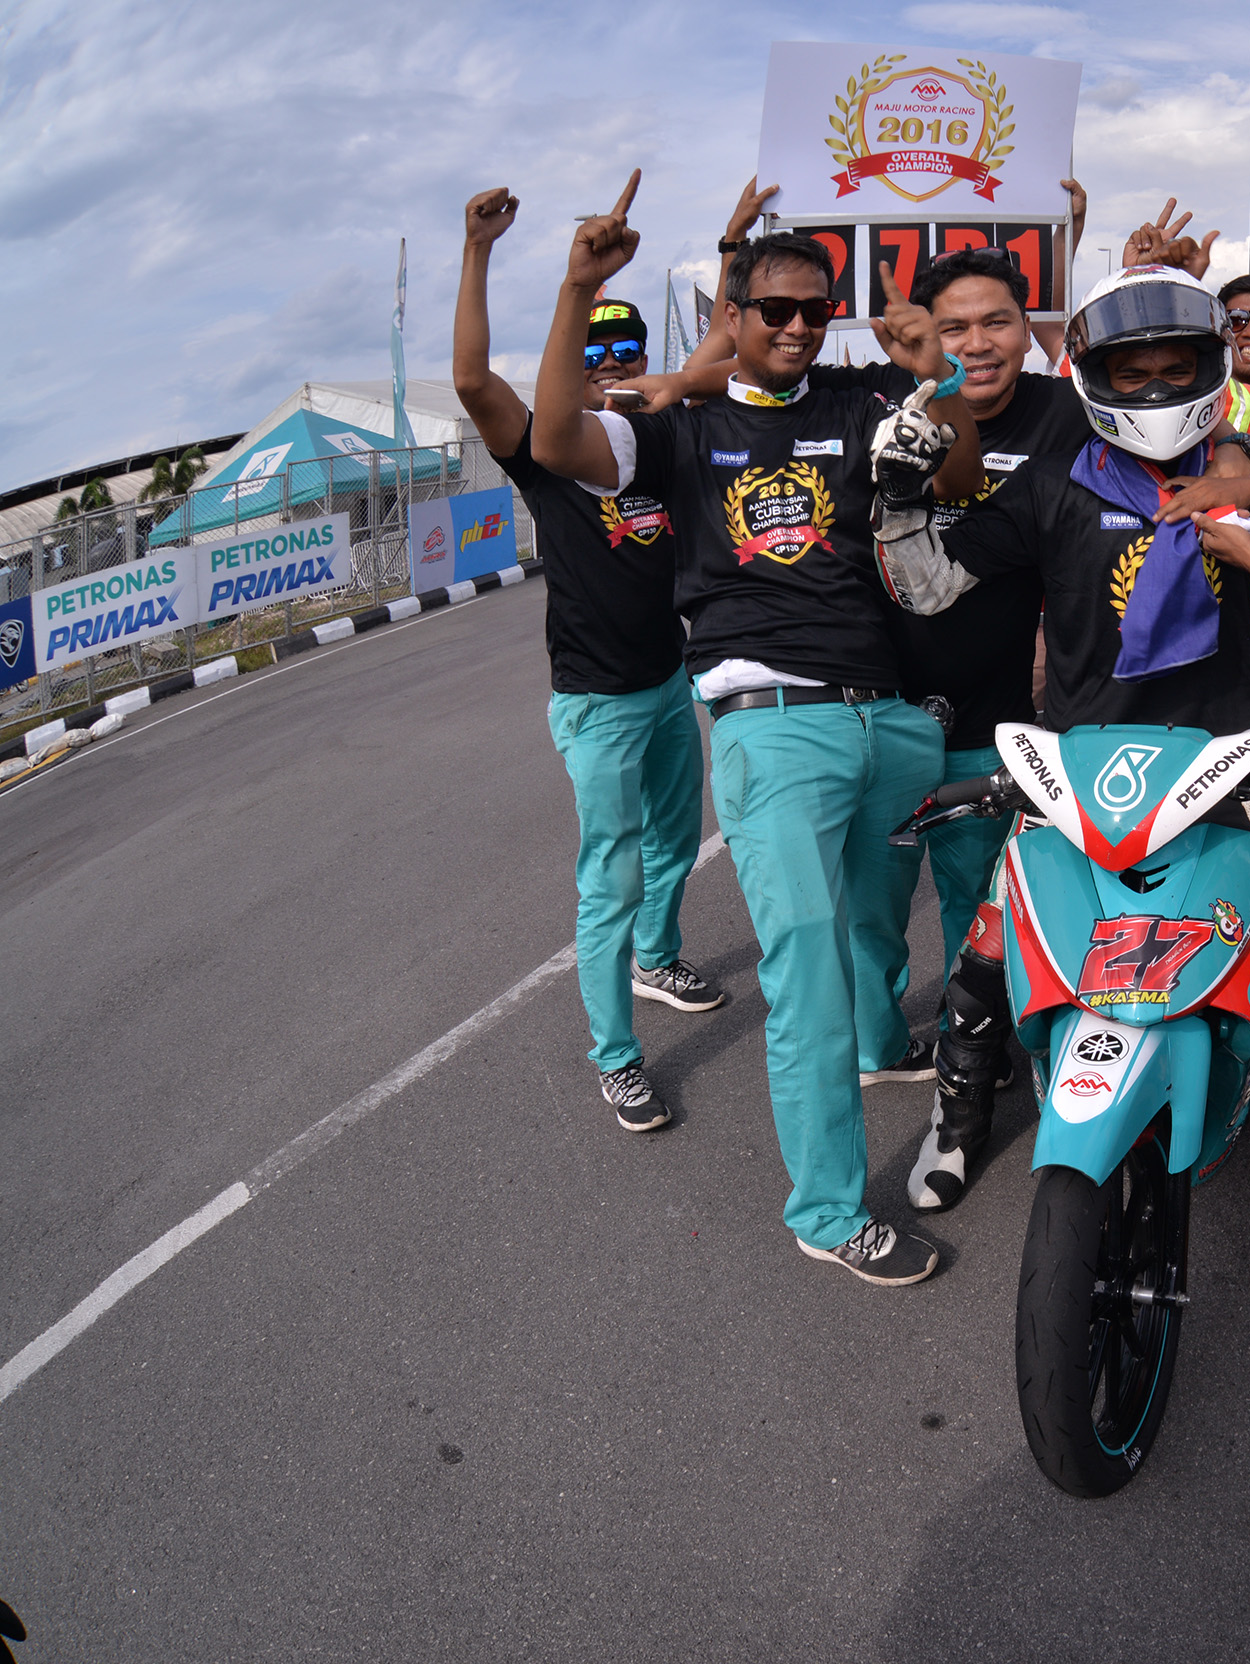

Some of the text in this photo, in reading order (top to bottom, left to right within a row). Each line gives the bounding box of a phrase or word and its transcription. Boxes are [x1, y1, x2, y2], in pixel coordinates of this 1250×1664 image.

[874, 103, 976, 116] MAJU MOTOR RACING
[877, 116, 969, 146] 2016
[891, 152, 950, 164] OVERALL
[886, 161, 954, 174] CHAMPION
[721, 453, 749, 462] YAMAHA
[758, 482, 796, 500] 206
[748, 501, 767, 512] AAM
[1111, 515, 1141, 525] YAMAHA
[767, 528, 801, 539] OVERALL
[766, 535, 805, 547] CHAMPION
[211, 524, 335, 573] PETRONAS
[775, 544, 800, 554] CP130
[208, 548, 339, 612] PRIMAX
[46, 560, 177, 620] PETRONAS
[46, 588, 183, 662] PRIMAX
[1012, 732, 1063, 802] PETRONAS
[1078, 914, 1214, 997] 27
[1088, 991, 1170, 1007] #KASMA
